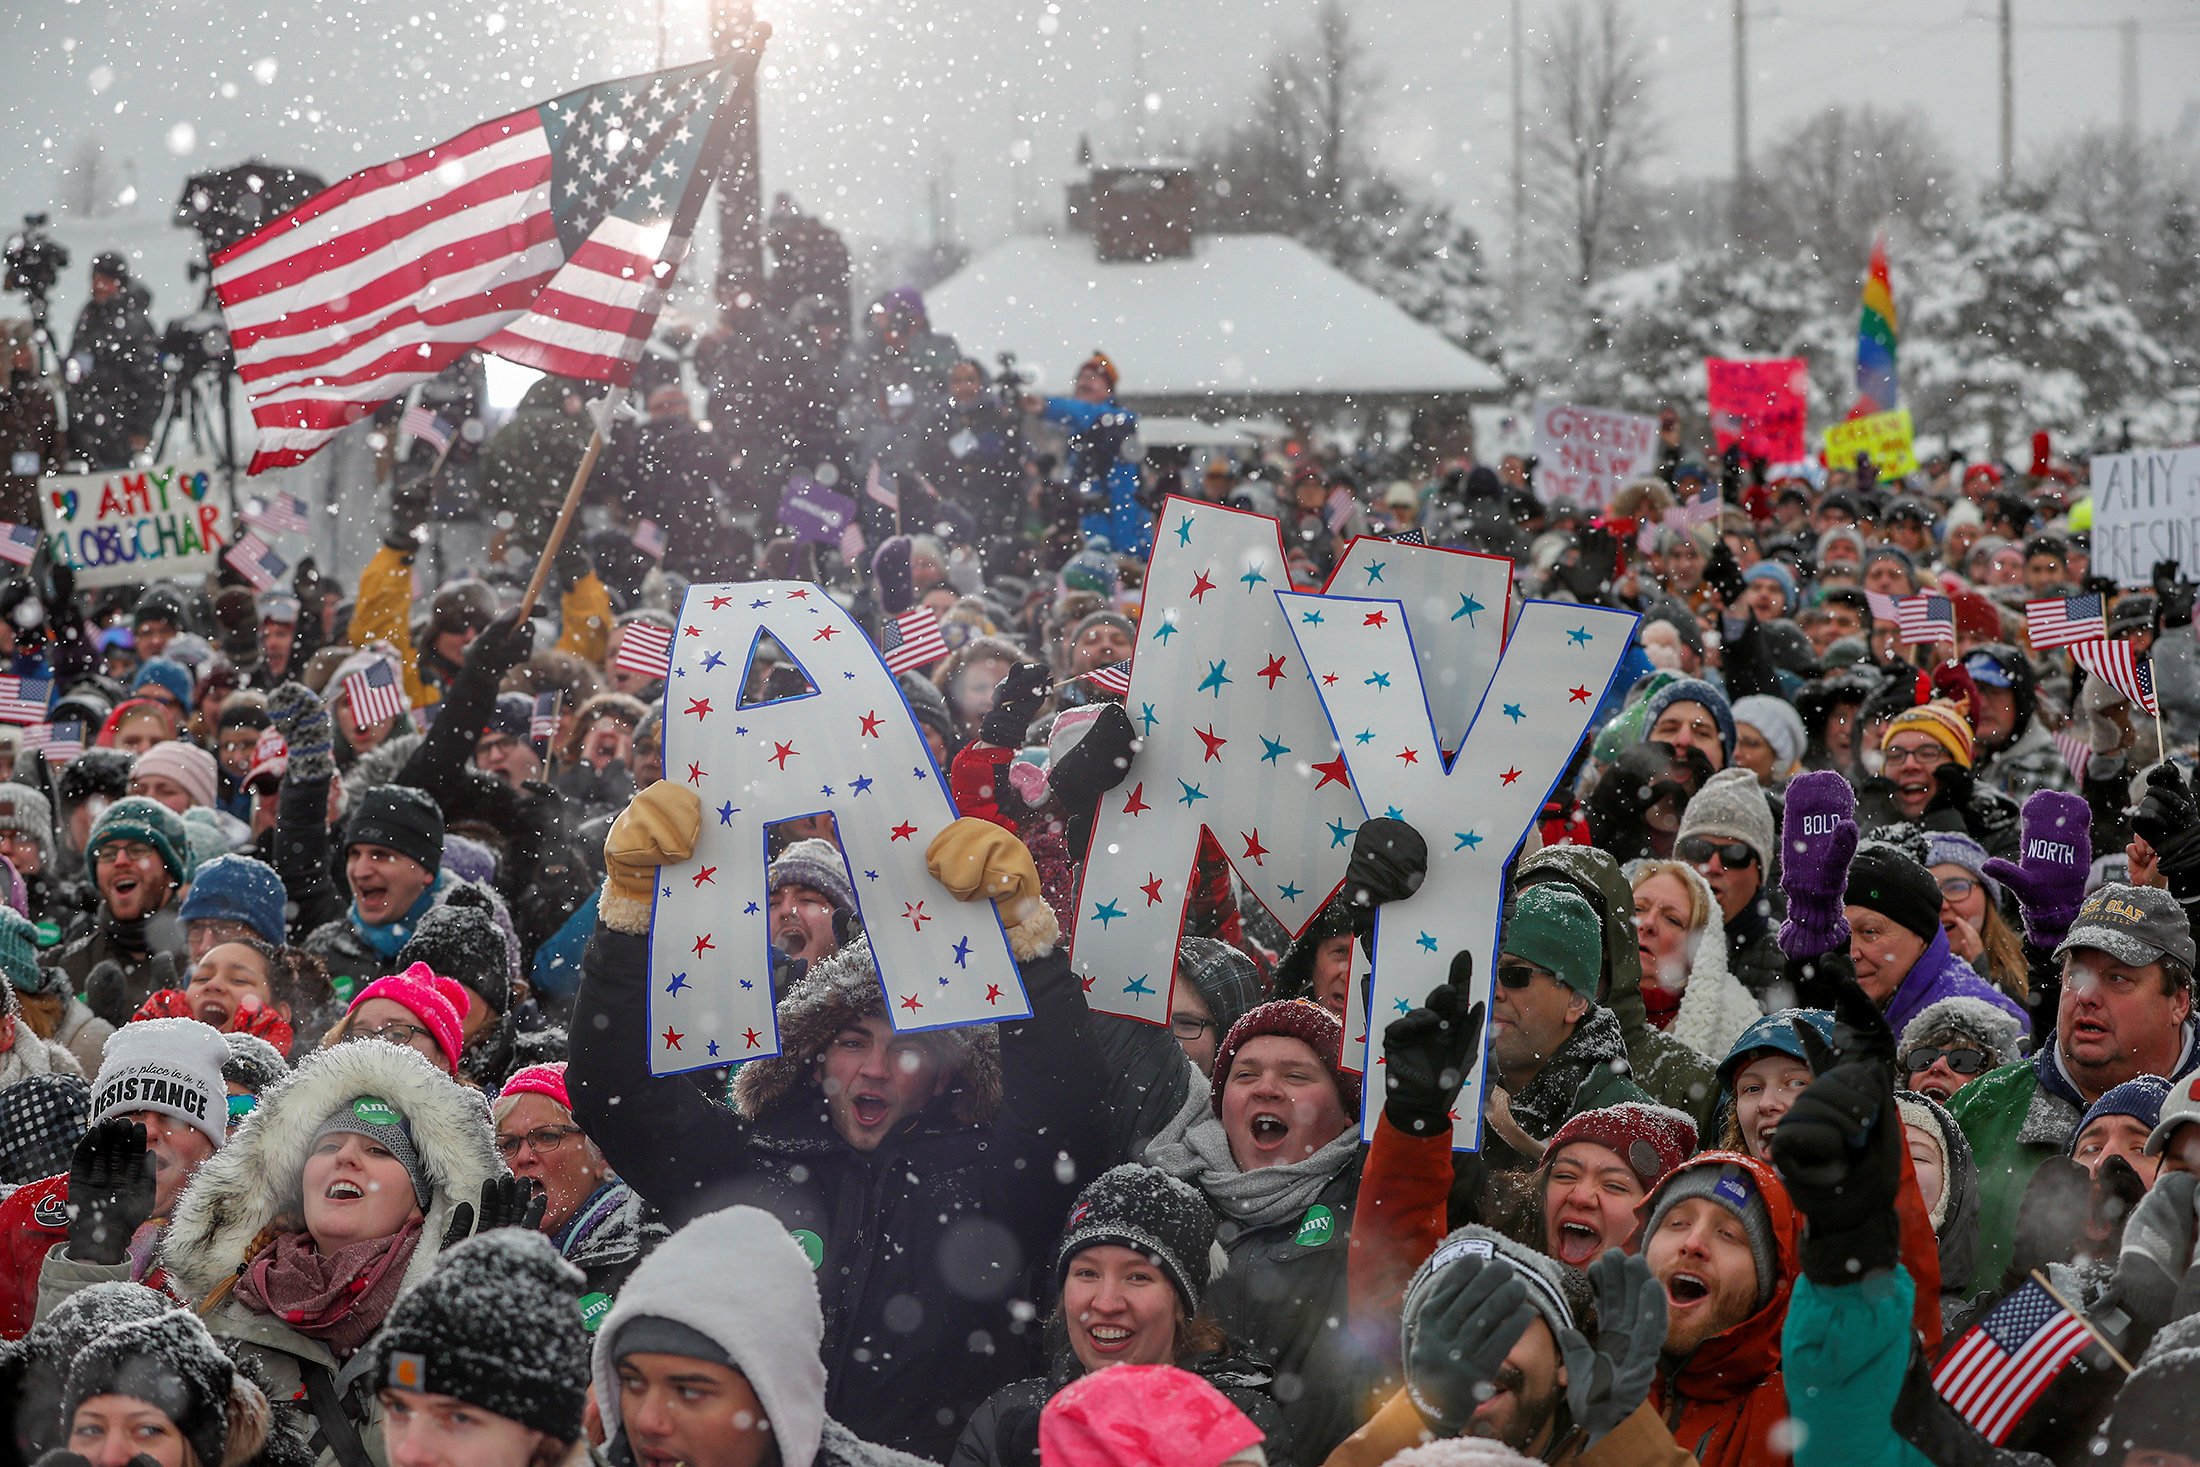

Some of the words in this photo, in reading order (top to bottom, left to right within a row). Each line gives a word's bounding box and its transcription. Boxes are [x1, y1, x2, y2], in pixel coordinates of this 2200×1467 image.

[1546, 405, 1652, 452] GREEN
[1560, 442, 1635, 475] NEW
[96, 465, 174, 521] AMY
[2101, 453, 2177, 512] AMY
[47, 504, 225, 570] KLOBUCHAR
[647, 494, 1640, 1152] AMY
[1803, 813, 1841, 835] BOLD
[2026, 838, 2075, 865] NORTH
[2104, 899, 2146, 923] OLAF
[137, 1062, 170, 1078] place
[170, 1068, 182, 1079] is
[93, 1077, 208, 1121] RESISTANCE
